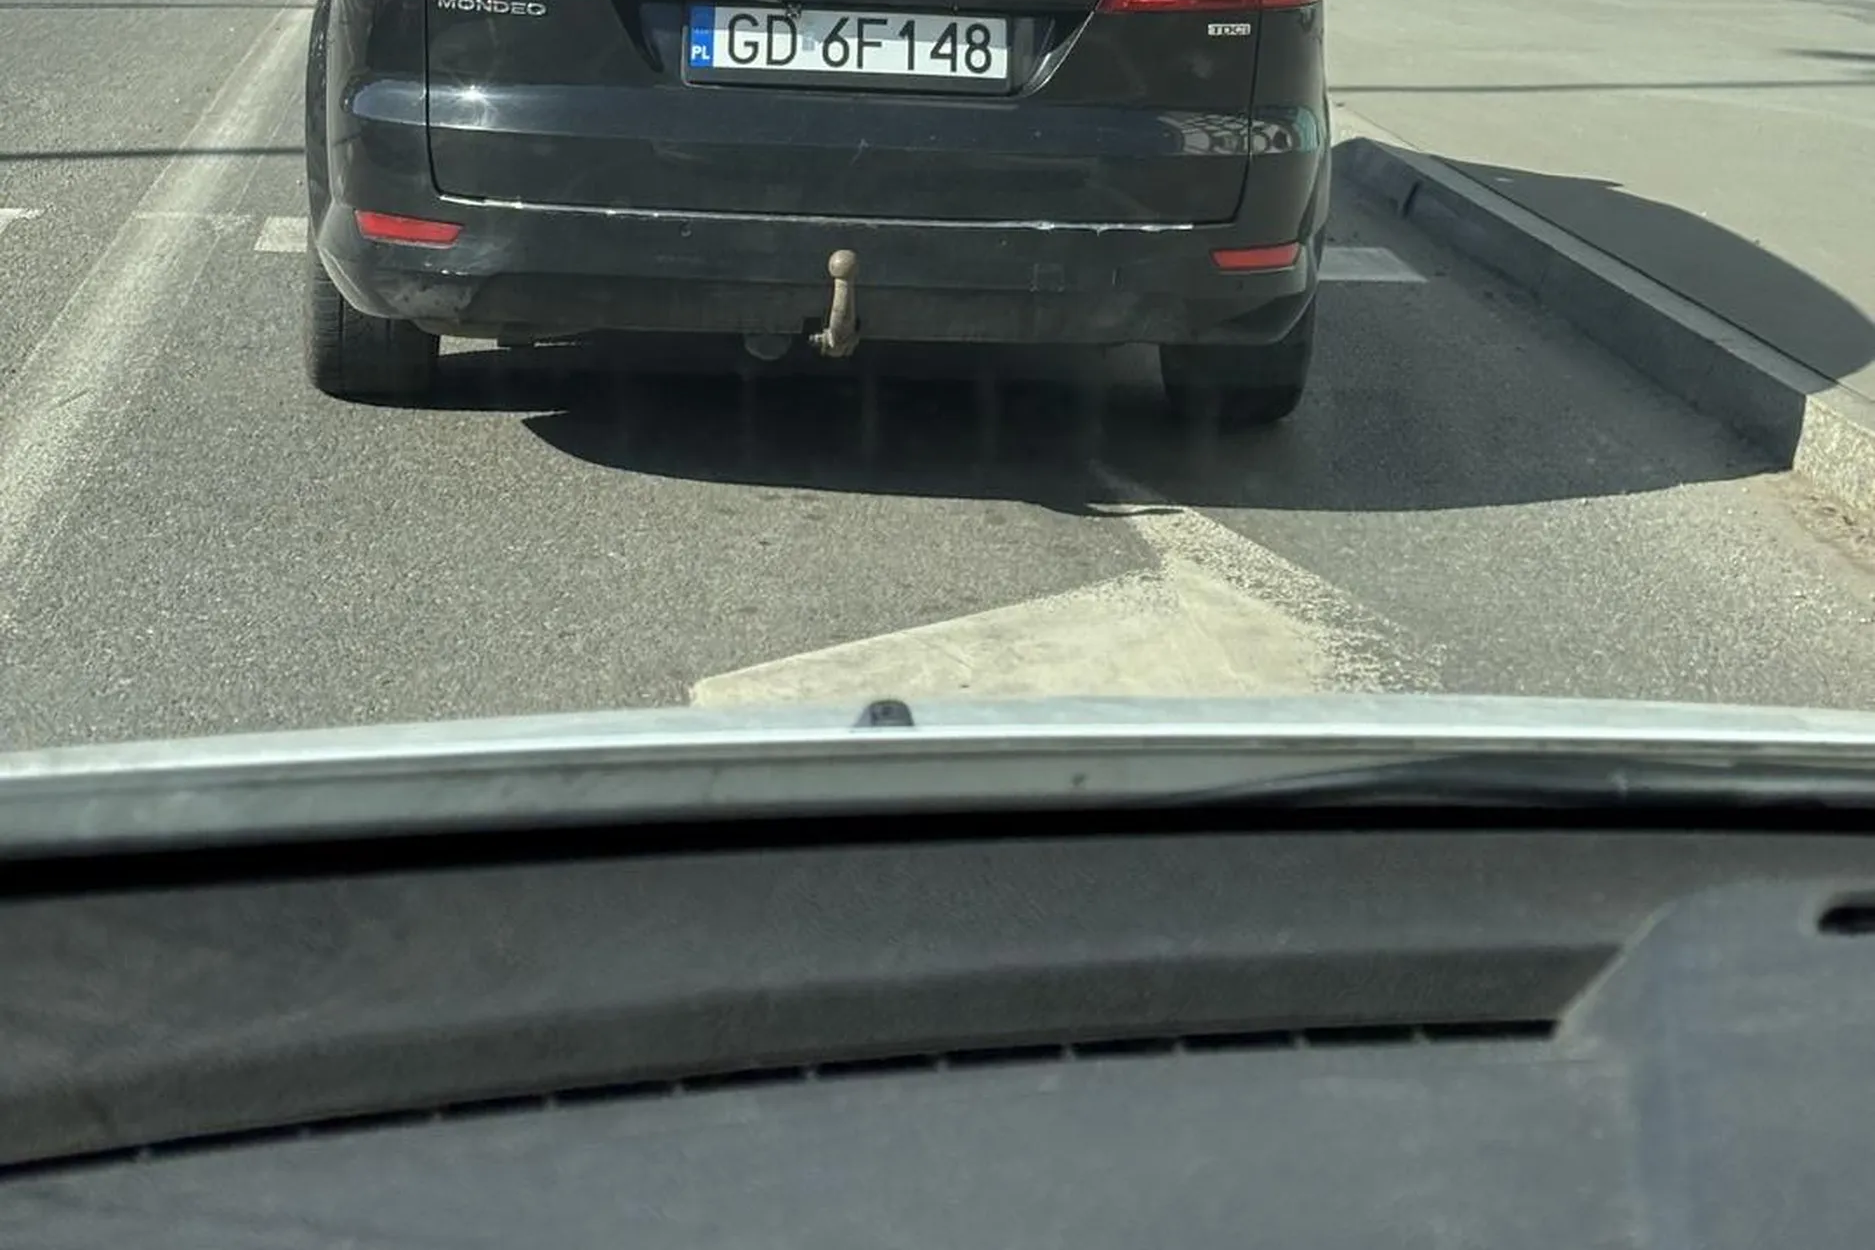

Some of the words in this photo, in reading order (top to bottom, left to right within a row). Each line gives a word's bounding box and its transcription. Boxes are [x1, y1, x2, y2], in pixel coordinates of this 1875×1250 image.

[691, 45, 711, 60] PL
[728, 13, 797, 66] GD
[822, 16, 992, 75] 6F148
